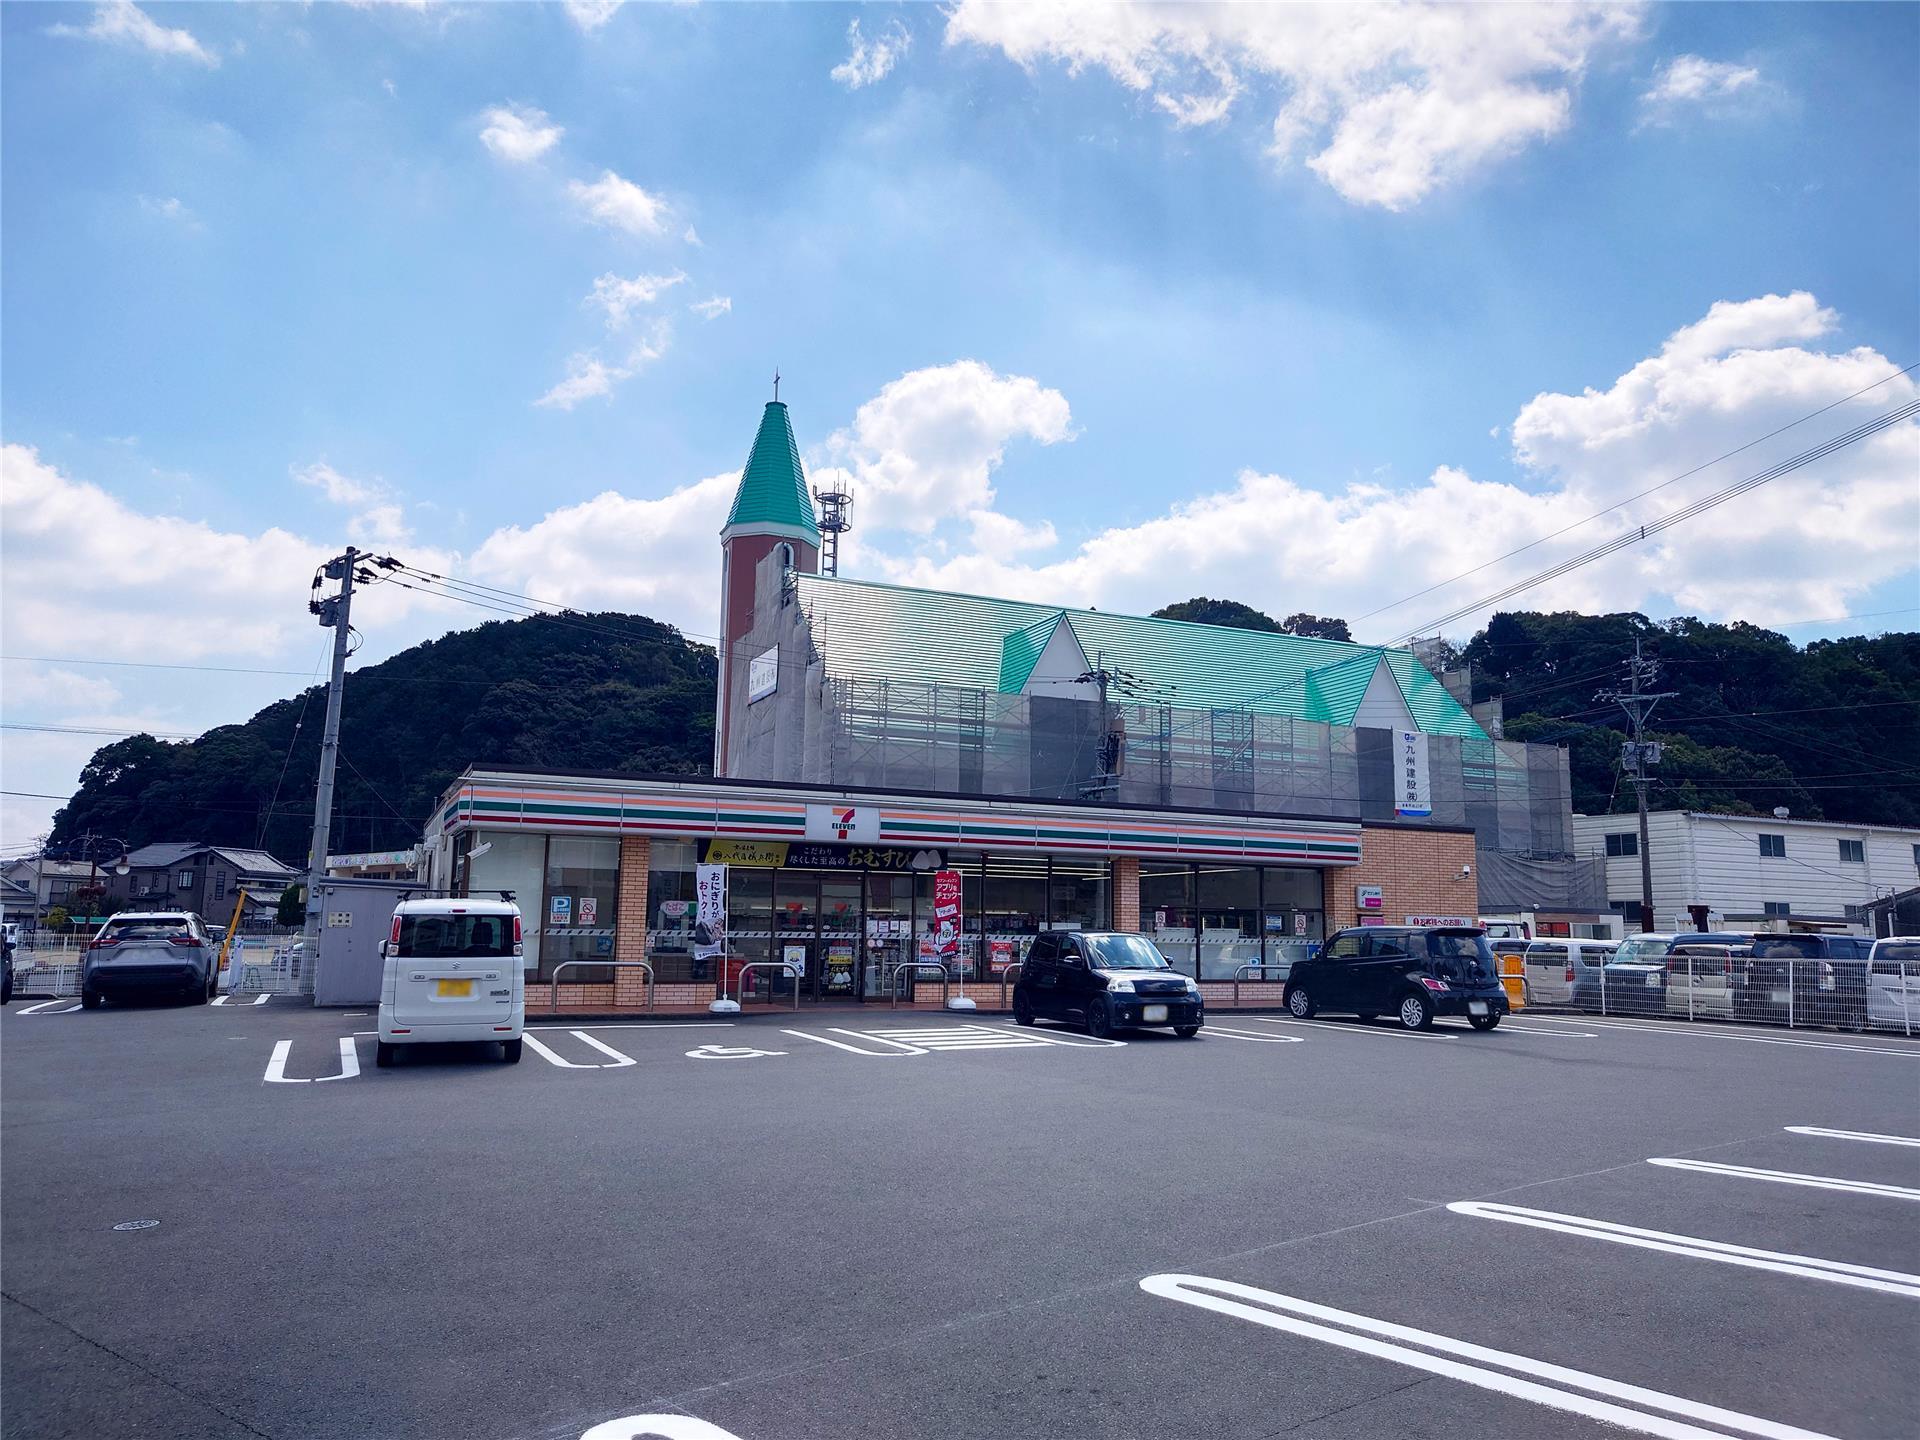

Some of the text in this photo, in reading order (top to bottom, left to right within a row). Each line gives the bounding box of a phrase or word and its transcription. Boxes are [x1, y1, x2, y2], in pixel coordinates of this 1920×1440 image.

[803, 847, 832, 855] こだわり
[789, 855, 845, 866] 尽くした至高の
[847, 848, 912, 868] おむすび
[936, 883, 958, 892] アプリを
[711, 871, 720, 919] おにぎりが
[936, 891, 958, 900] チェック
